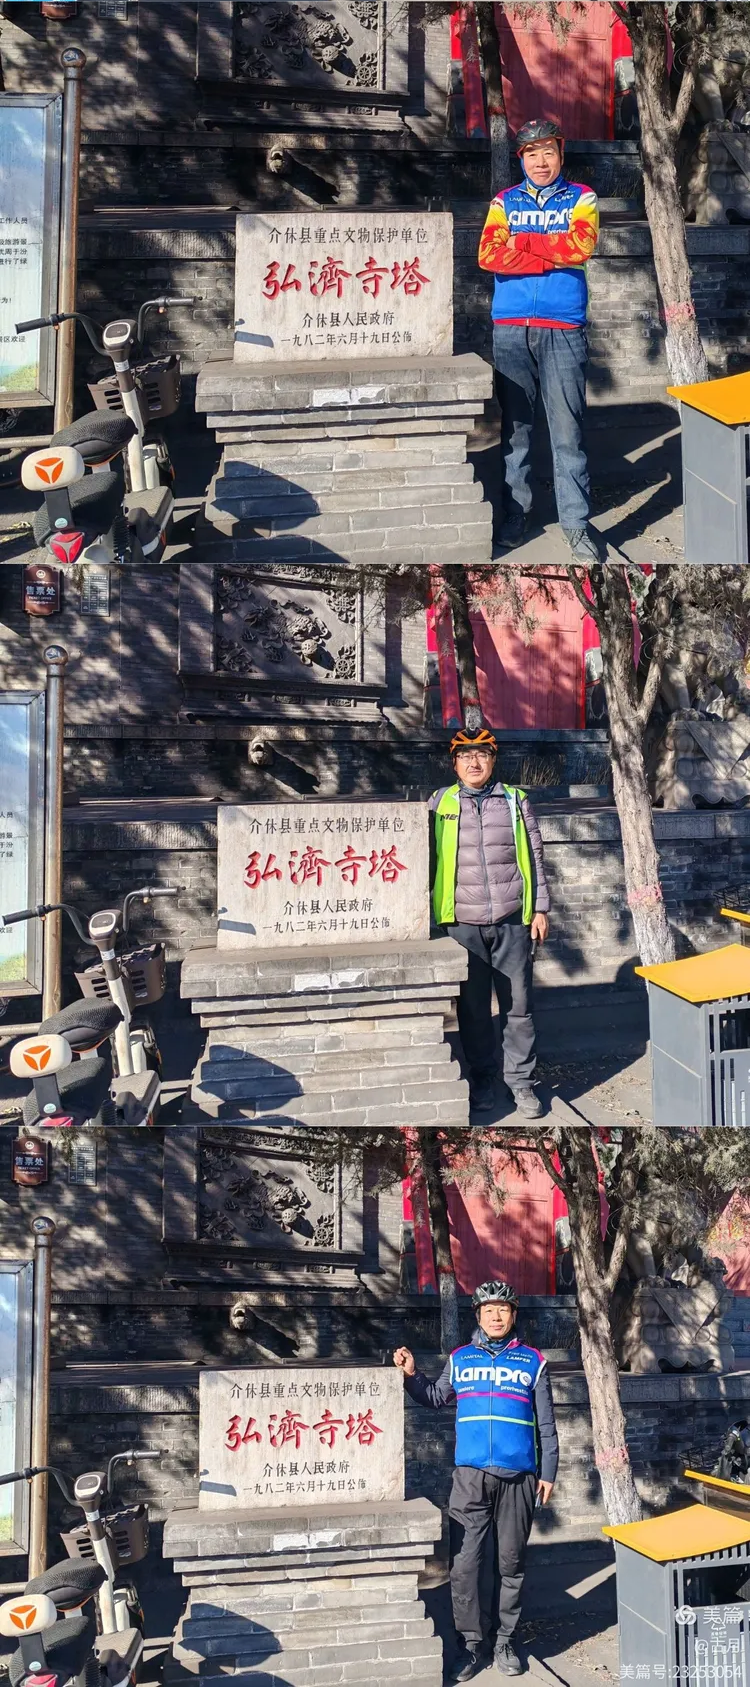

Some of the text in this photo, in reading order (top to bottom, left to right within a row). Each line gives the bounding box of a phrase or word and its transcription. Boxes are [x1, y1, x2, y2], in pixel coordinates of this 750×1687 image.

[268, 227, 428, 244] 介休县重点文物保护单位
[262, 256, 431, 301] 弘濟寺塔
[302, 310, 395, 328] 介休县人民政府
[26, 585, 56, 596] 售票处
[249, 817, 405, 834] 介休县重点文物保护单位
[243, 844, 409, 890] 弘濟寺塔
[283, 897, 373, 915] 介休县人民政府
[15, 1156, 44, 1166] 售票处
[230, 1381, 381, 1399] 介休县重点文物保护单位
[224, 1408, 384, 1452] 弘濟寺塔
[263, 1460, 350, 1478] 介休县人民政府
